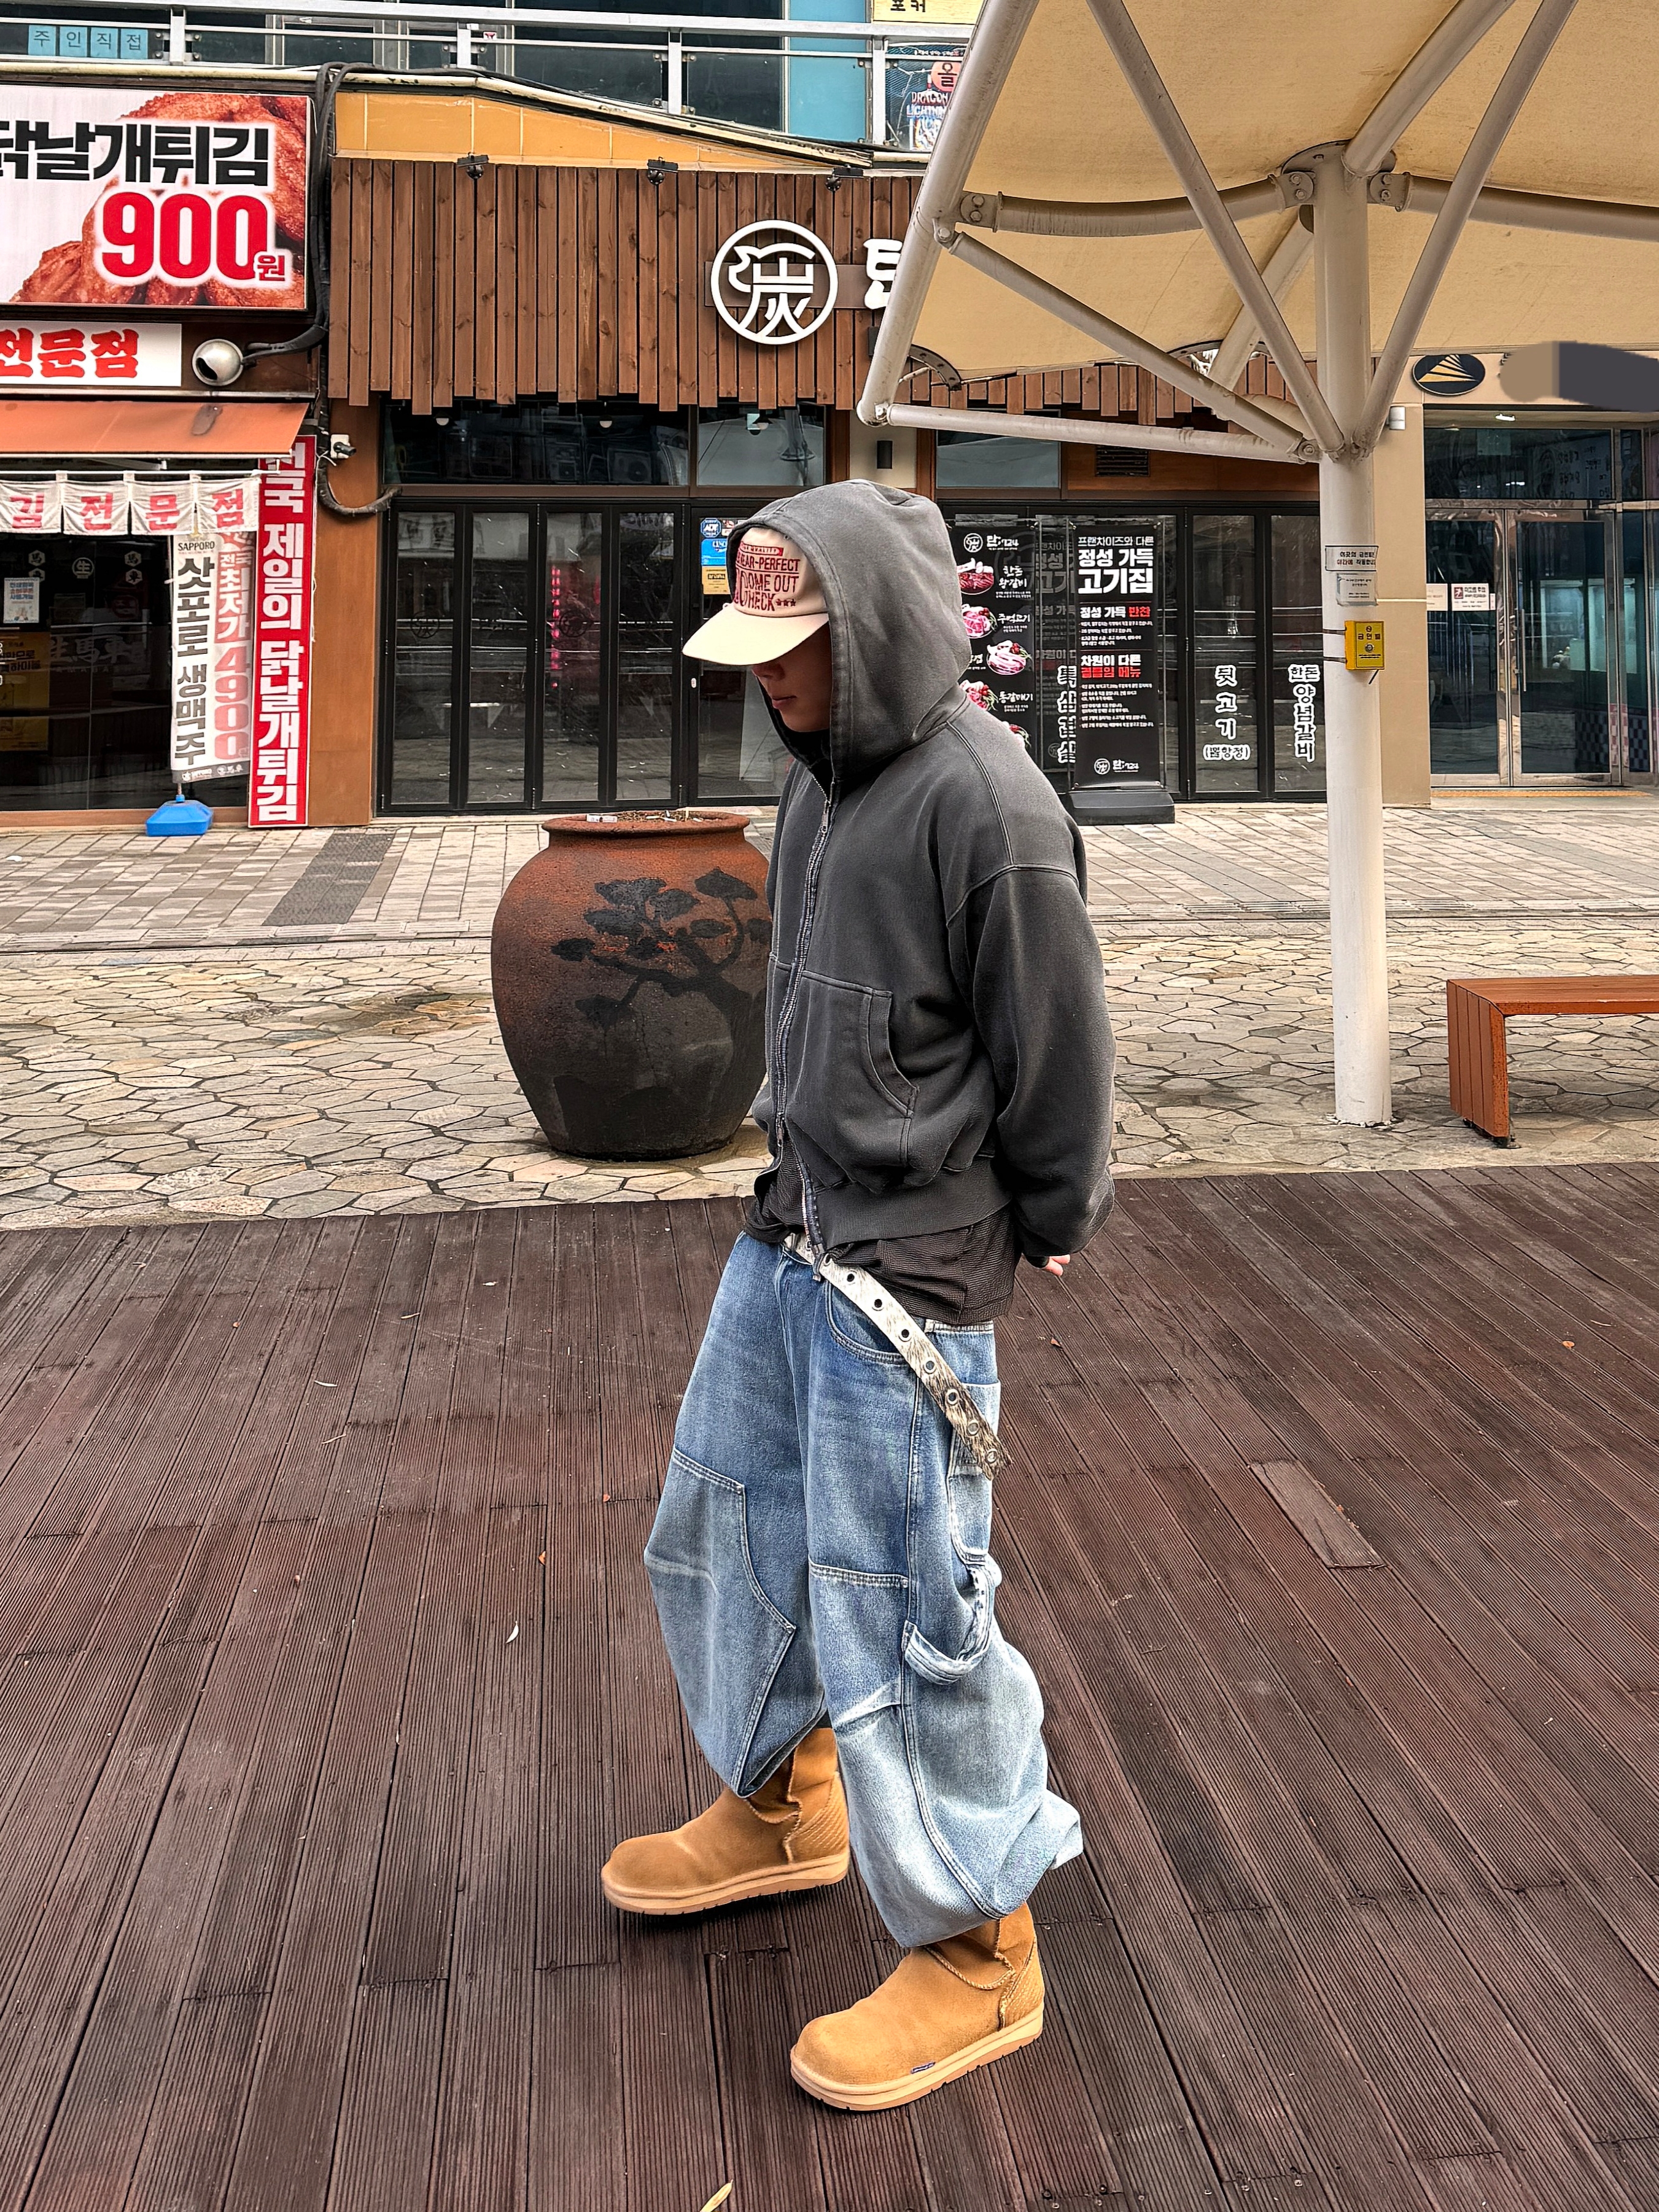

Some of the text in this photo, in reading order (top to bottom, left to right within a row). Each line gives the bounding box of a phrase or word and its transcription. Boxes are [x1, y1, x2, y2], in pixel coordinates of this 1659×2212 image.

[0, 327, 139, 378] 전문점
[177, 541, 216, 551] SAPPORO
[1135, 536, 1154, 546] 다른
[1078, 548, 1154, 567] 정성 가득
[262, 522, 305, 631] 제일의
[774, 575, 799, 592] OUT
[1078, 568, 1153, 594] 고기집
[177, 557, 215, 657] 삿포로
[1079, 606, 1102, 619] 정성
[1104, 605, 1127, 618] 가득
[1081, 654, 1141, 667] 차원이 다른
[1118, 666, 1141, 678] 메뉴
[1289, 665, 1319, 682] 한돈
[174, 664, 208, 766] 생맥주
[1294, 684, 1316, 761] 양념갈비
[257, 640, 305, 821] 닭날개튀김
